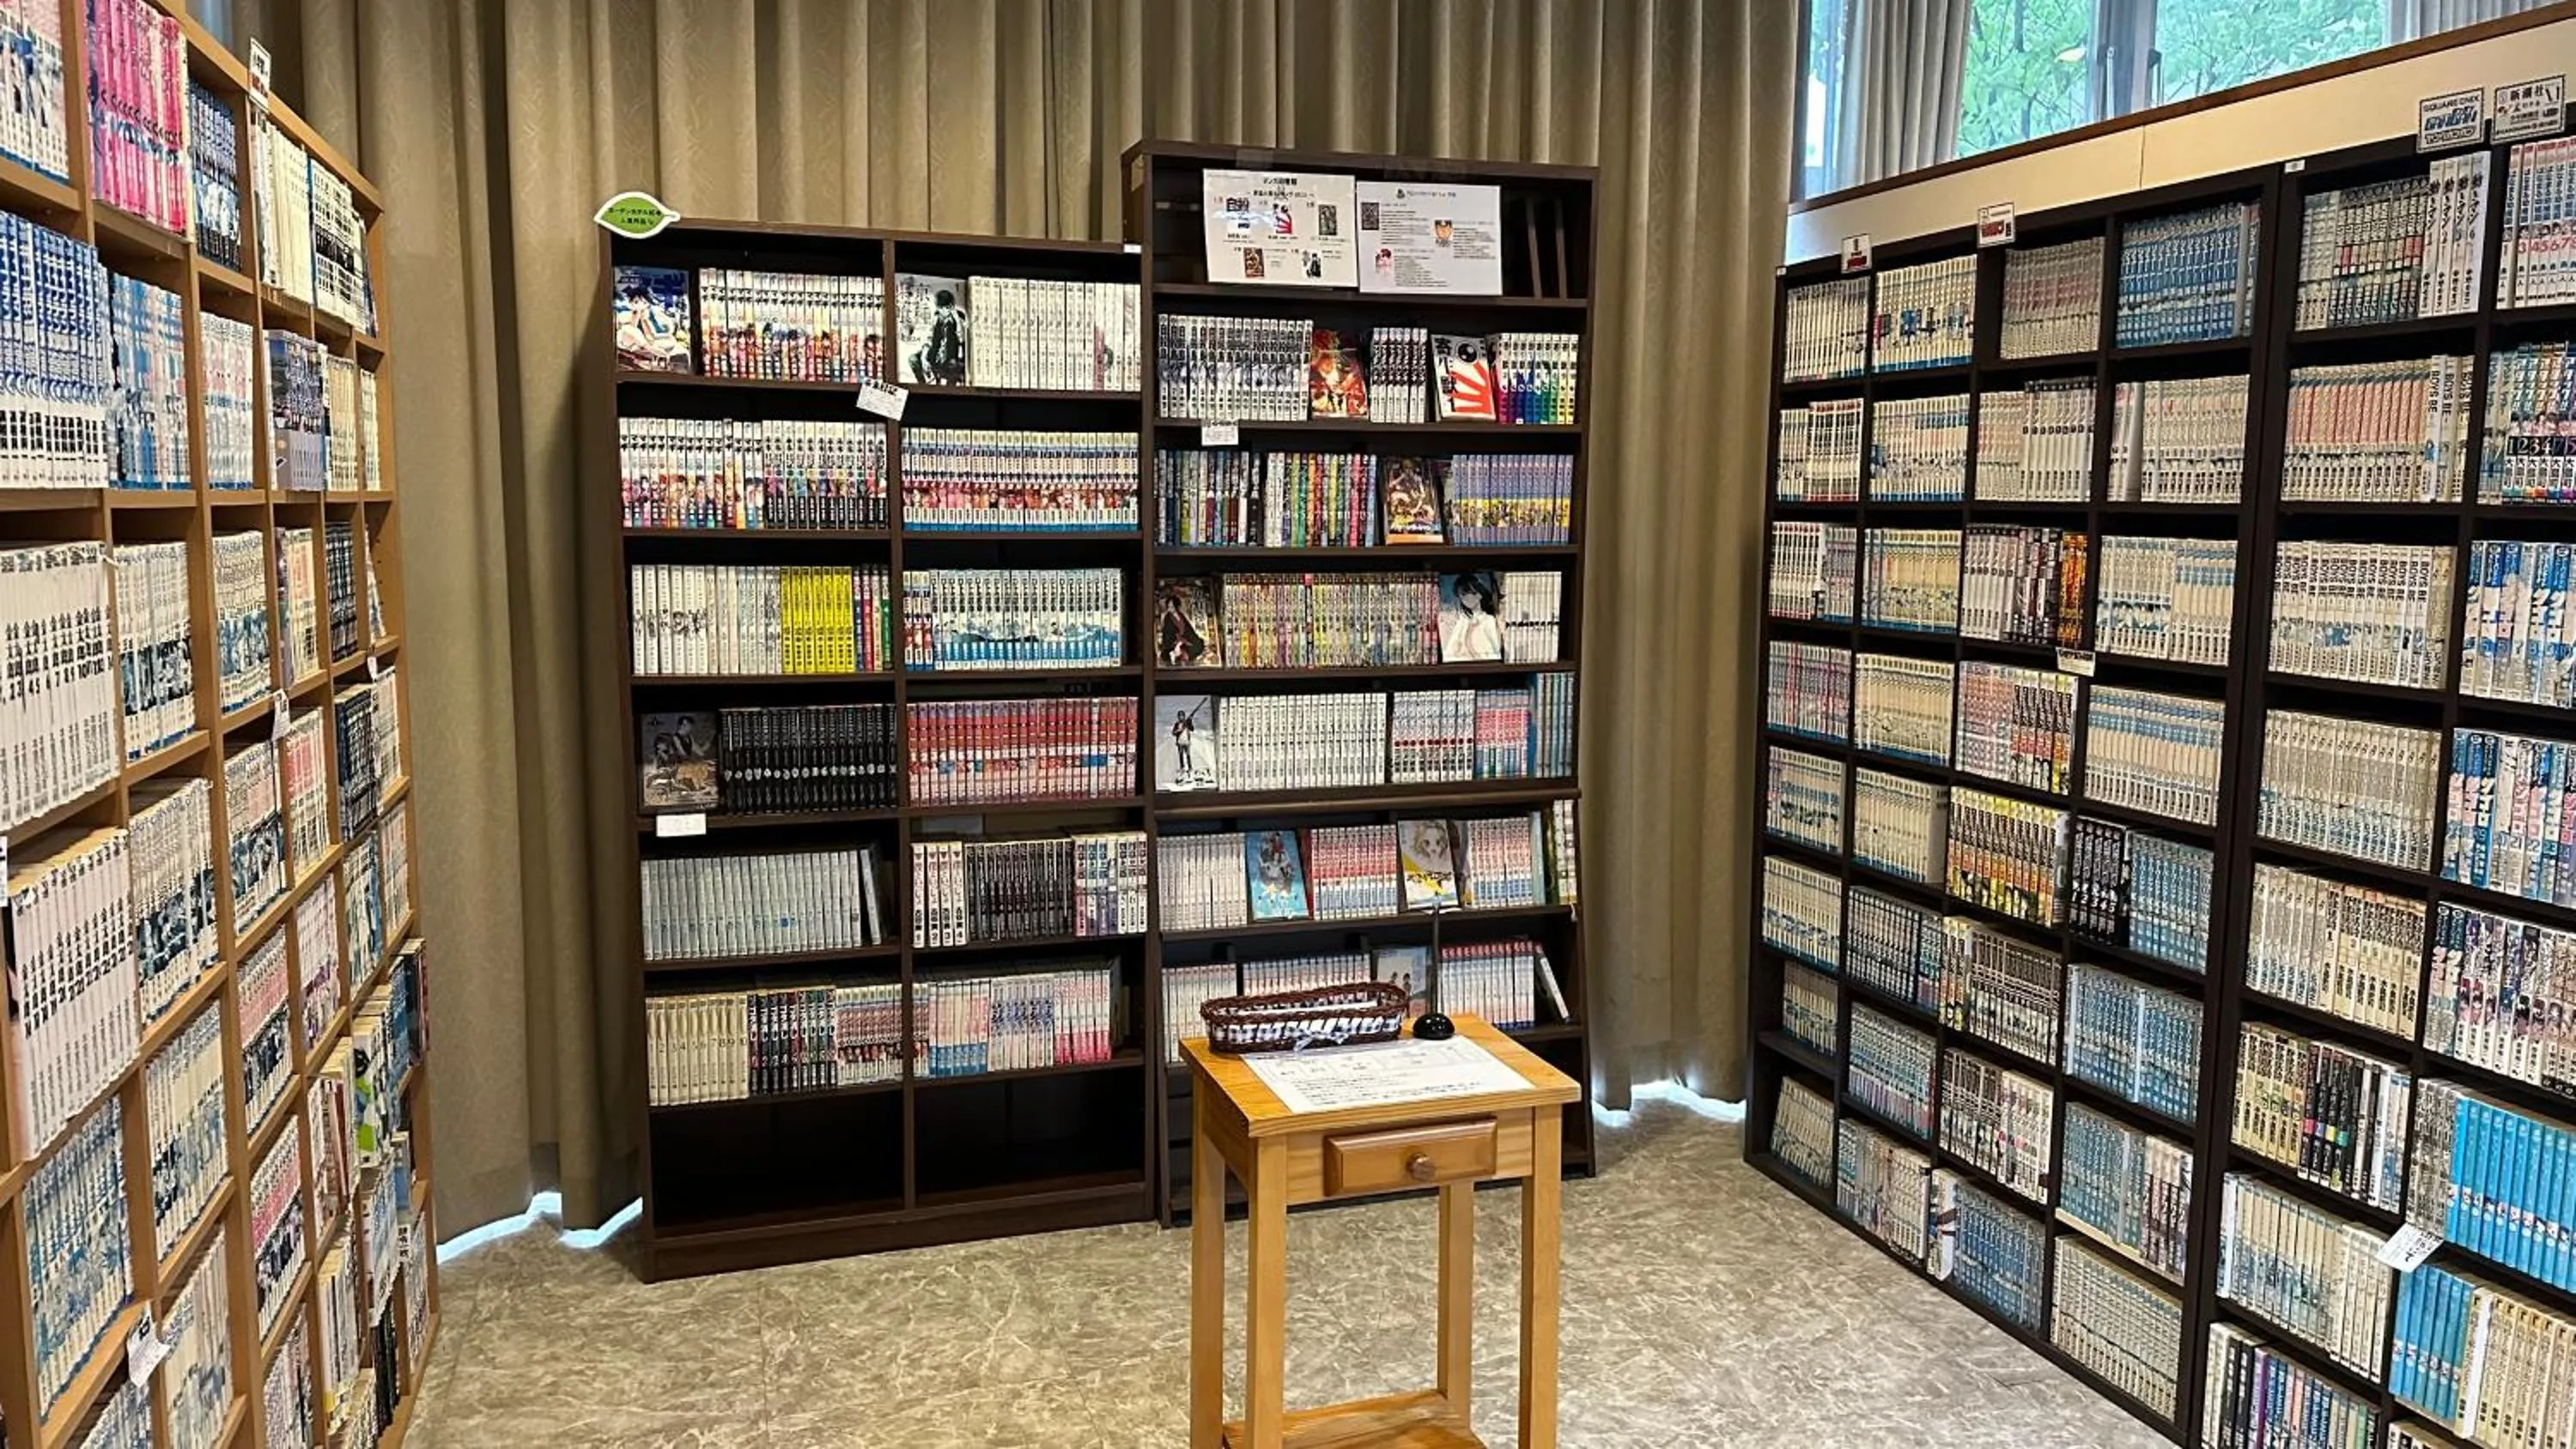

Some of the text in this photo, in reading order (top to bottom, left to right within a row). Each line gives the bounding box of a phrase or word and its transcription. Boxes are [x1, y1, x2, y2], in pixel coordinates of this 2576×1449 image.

[2518, 242, 2526, 254] 3
[2531, 242, 2538, 252] 4
[2540, 240, 2548, 252] 5
[2549, 239, 2559, 250] 6
[2561, 236, 2567, 248] 7
[2508, 439, 2513, 454] 1
[2517, 438, 2528, 454] 2
[2529, 439, 2540, 455] 3
[2541, 437, 2552, 455] 4
[2081, 894, 2088, 904] 2
[2091, 897, 2099, 907] 3
[2099, 900, 2107, 910] 4
[2108, 903, 2116, 912] 5
